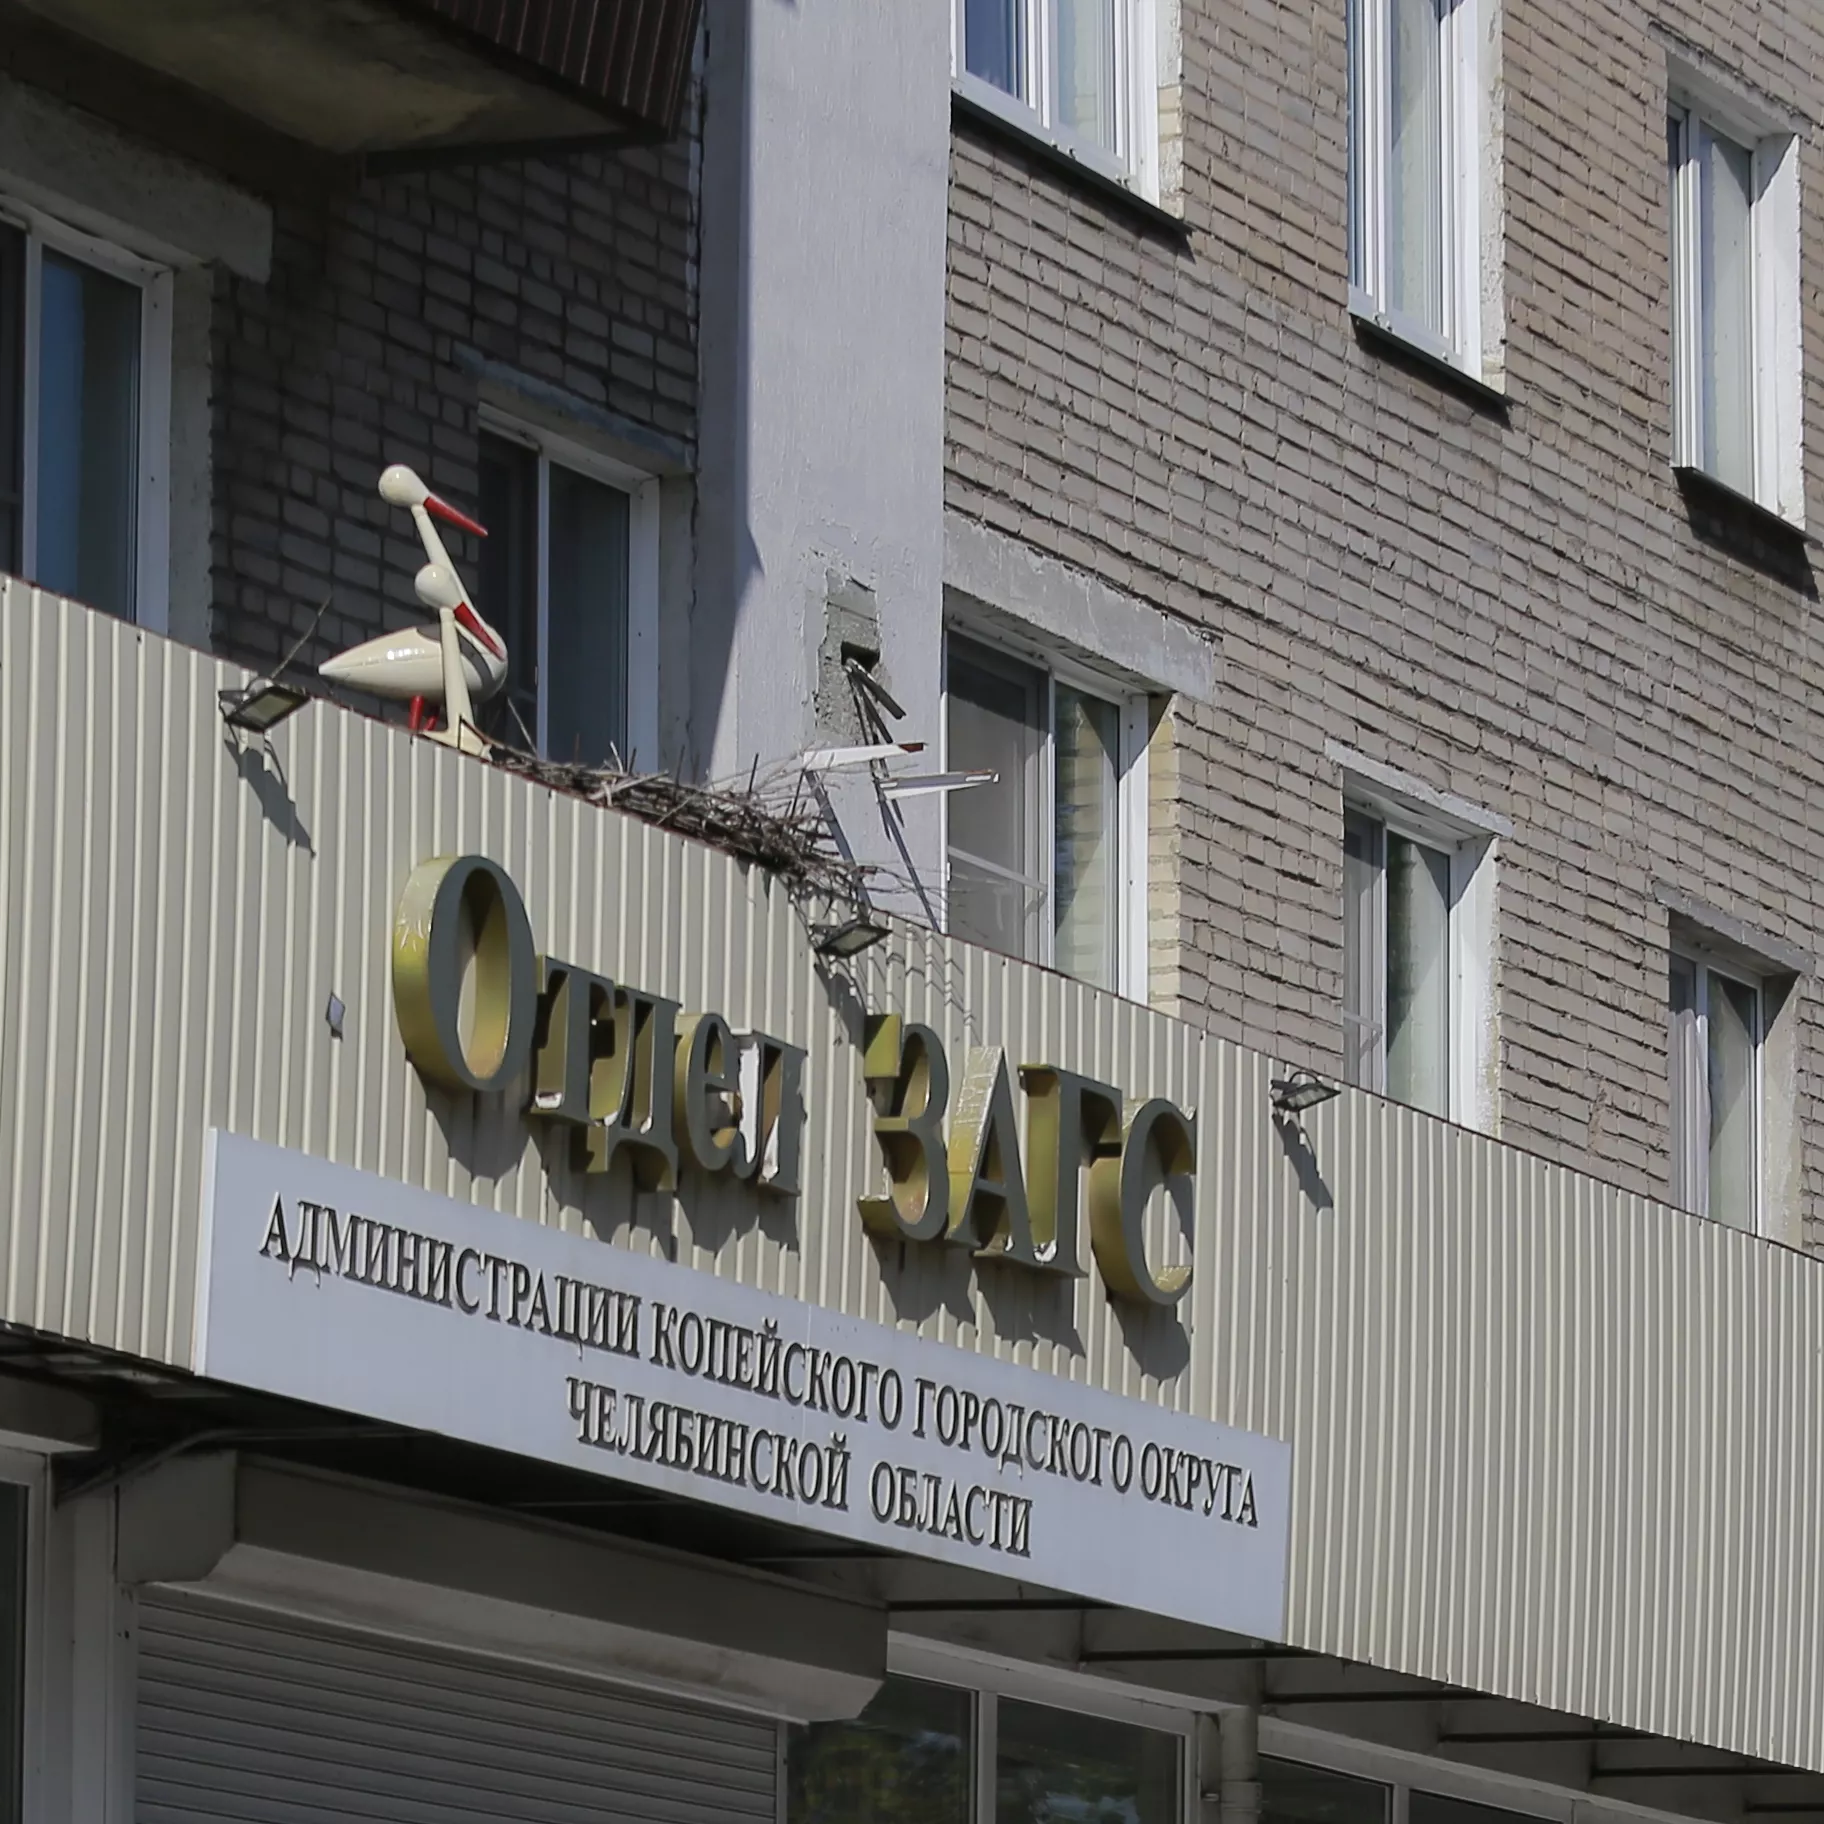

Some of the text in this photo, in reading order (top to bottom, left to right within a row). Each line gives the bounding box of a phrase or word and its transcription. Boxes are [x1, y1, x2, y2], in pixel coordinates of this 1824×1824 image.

[393, 855, 1196, 1306] Отдел ЗАГС
[259, 1191, 1259, 1528] АДМИНИСТРАЦИИ КОПЕЙСКОГО ГОРОДСКОГО ОКРУГА
[566, 1376, 1034, 1559] ЧЕЛЯБИНСКОЙ ОБЛАСТИ
